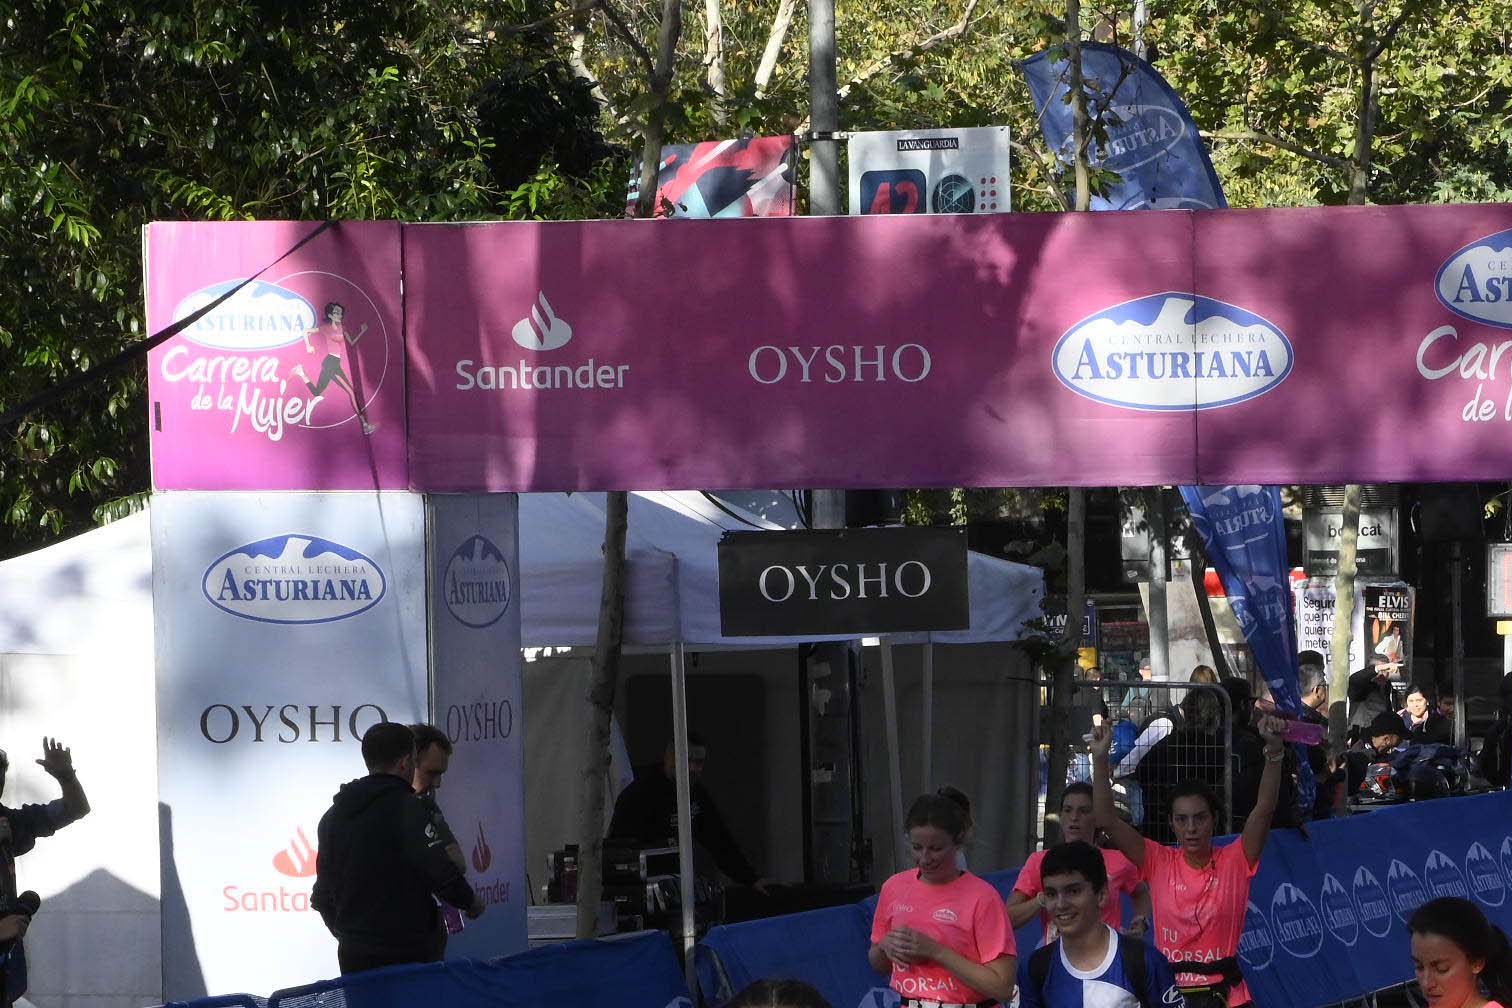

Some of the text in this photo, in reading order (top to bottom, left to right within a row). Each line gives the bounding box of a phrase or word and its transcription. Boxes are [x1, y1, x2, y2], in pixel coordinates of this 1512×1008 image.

[1109, 333, 1266, 345] CENTRAL LECHERA
[161, 345, 280, 383] Carrera
[456, 359, 630, 390] Santander
[748, 343, 931, 385] OYSHO
[1071, 337, 1275, 380] ASTURIANA
[191, 376, 325, 441] de la Mujer
[1462, 382, 1496, 422] de
[217, 568, 373, 602] ASTURIANA
[244, 564, 367, 576] CENTRAL LECHERA
[759, 559, 932, 604] OYSHO
[449, 571, 506, 605] ASTURIANA
[1378, 596, 1409, 608] ELVIS
[1303, 613, 1320, 624] que
[447, 700, 513, 744] OYSHO
[223, 885, 312, 913] Santa
[1162, 927, 1178, 943] TU
